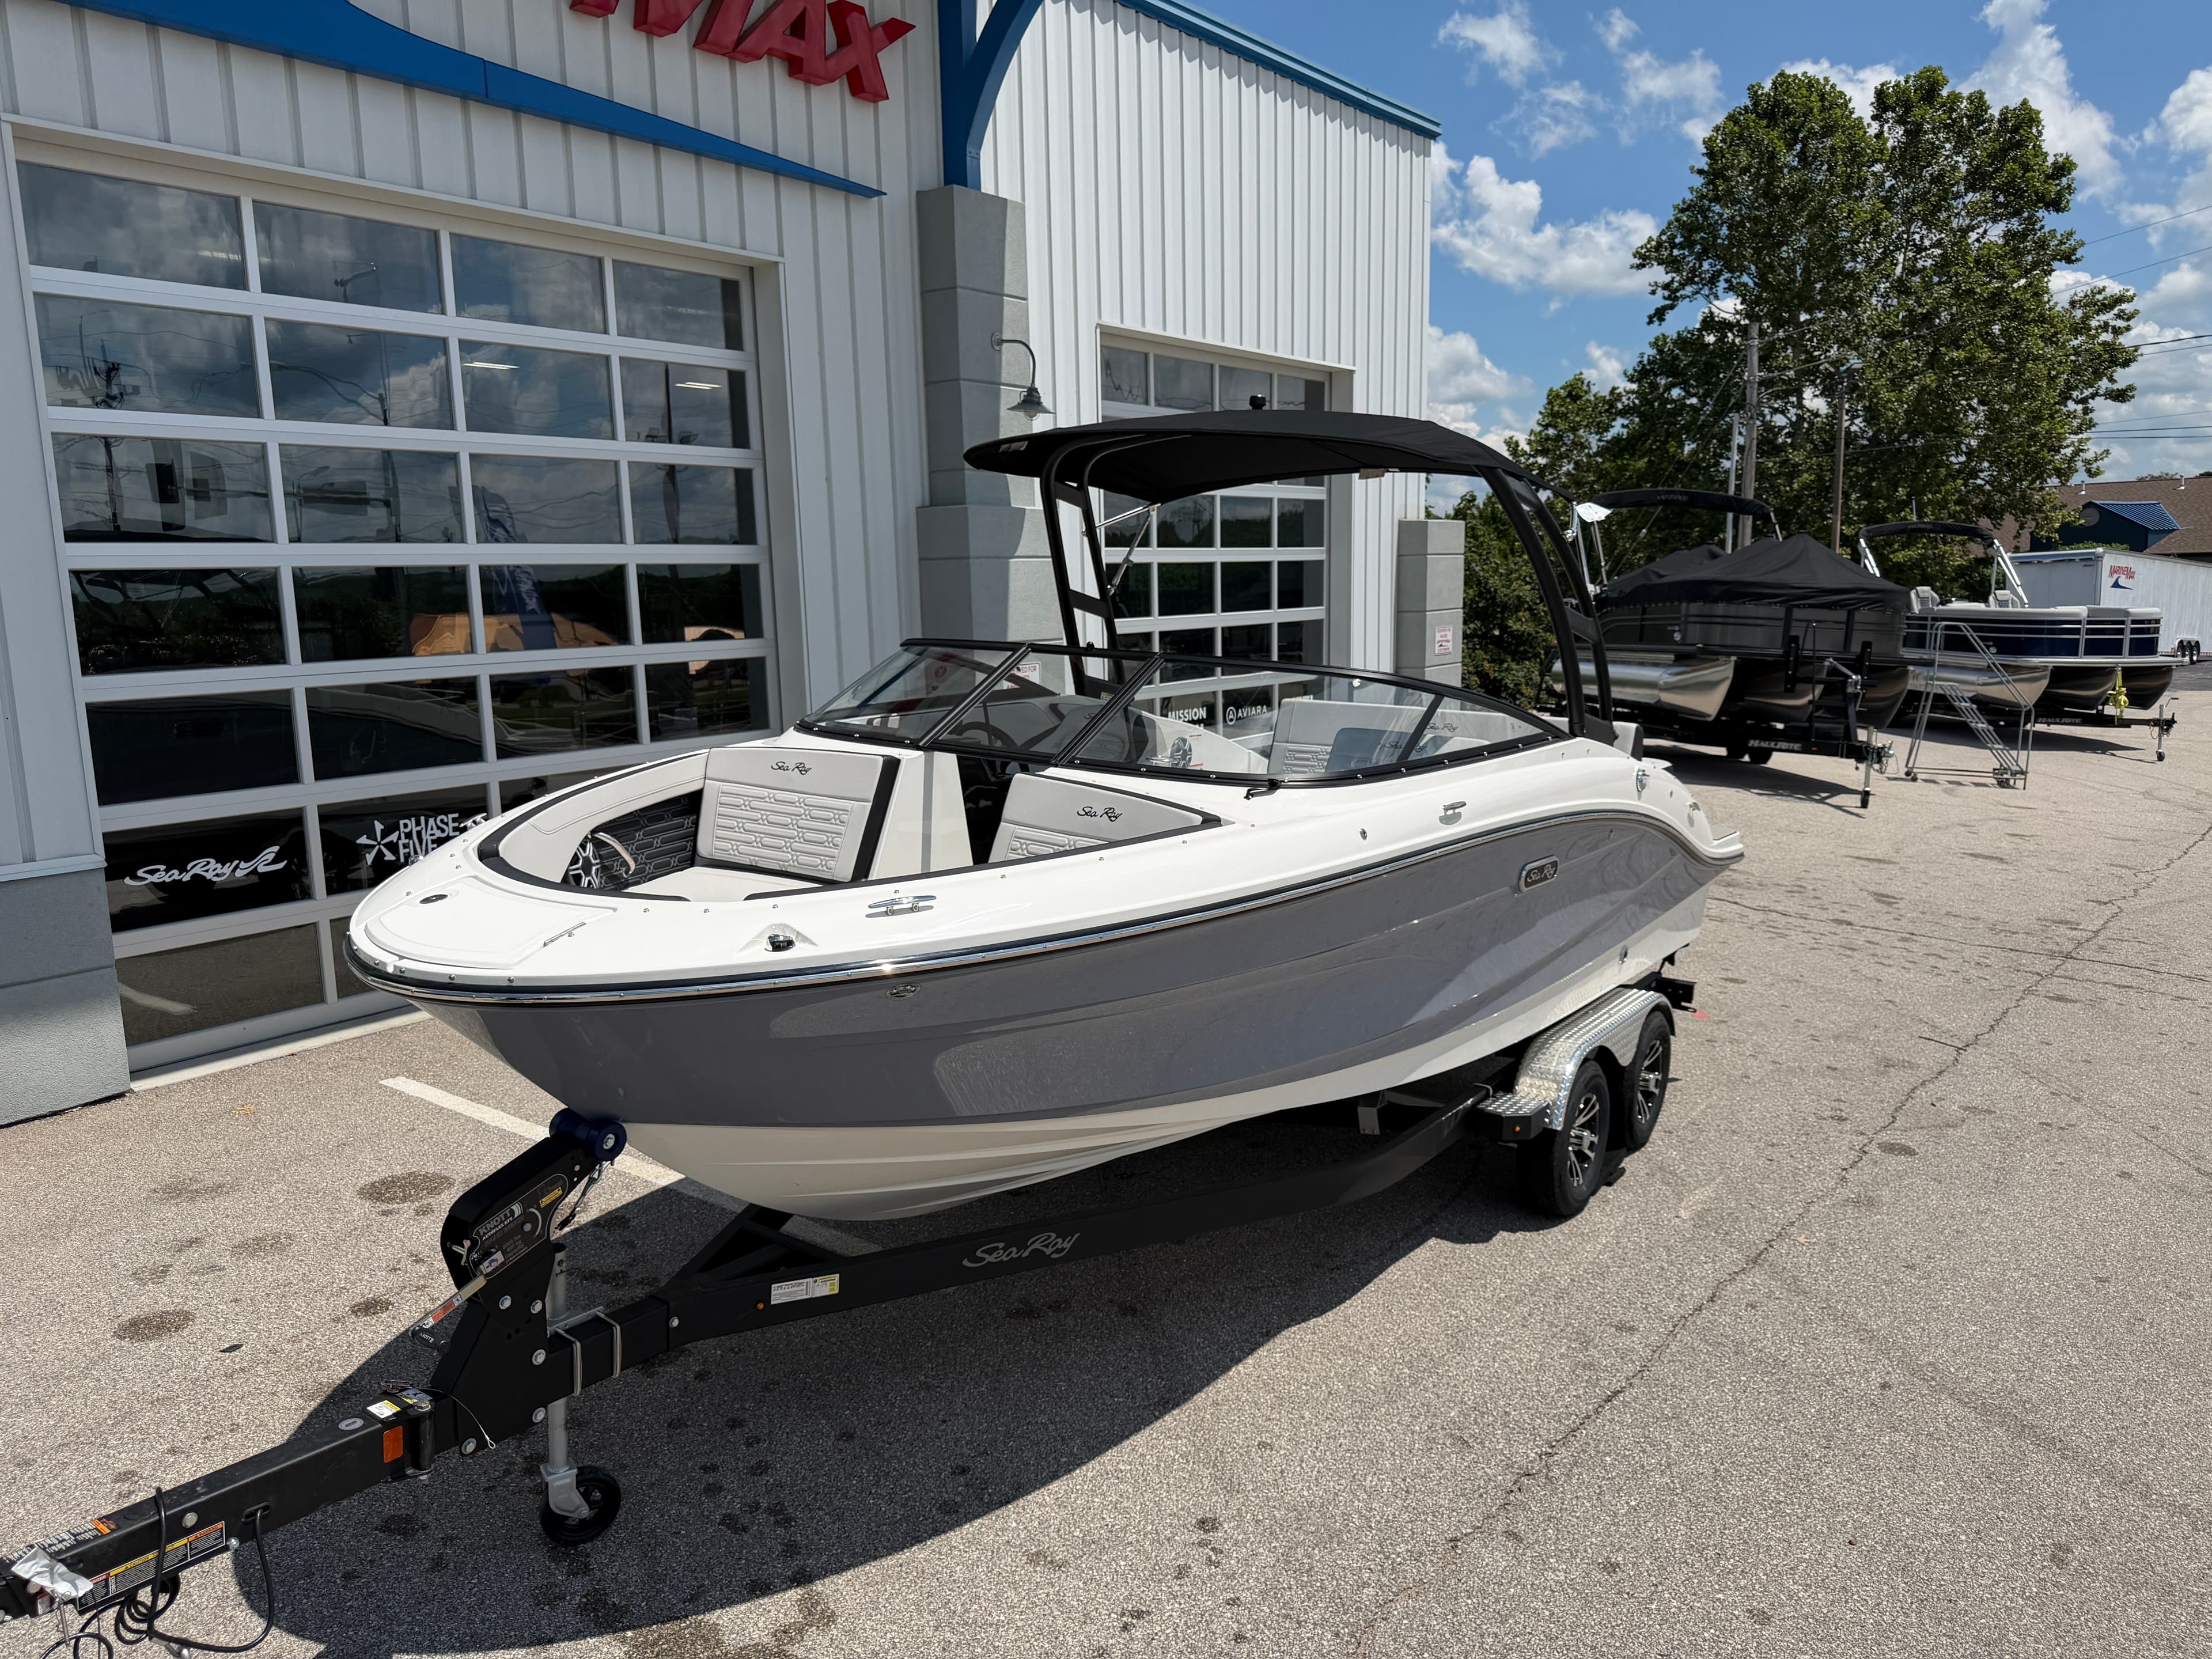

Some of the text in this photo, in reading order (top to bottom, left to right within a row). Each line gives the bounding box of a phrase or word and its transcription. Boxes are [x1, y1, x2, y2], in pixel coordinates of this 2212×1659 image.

[1168, 706, 1207, 722] MISSION
[1237, 704, 1267, 718] AVIARA
[771, 761, 812, 775] Sea Ray
[1077, 806, 1123, 822] Sea Ray
[399, 813, 460, 840] PHASE
[124, 858, 240, 885] Sea Ray
[1527, 864, 1556, 882] Sea Ray
[479, 1208, 511, 1237] KNOTT
[962, 1232, 1081, 1267] Sea Ray
